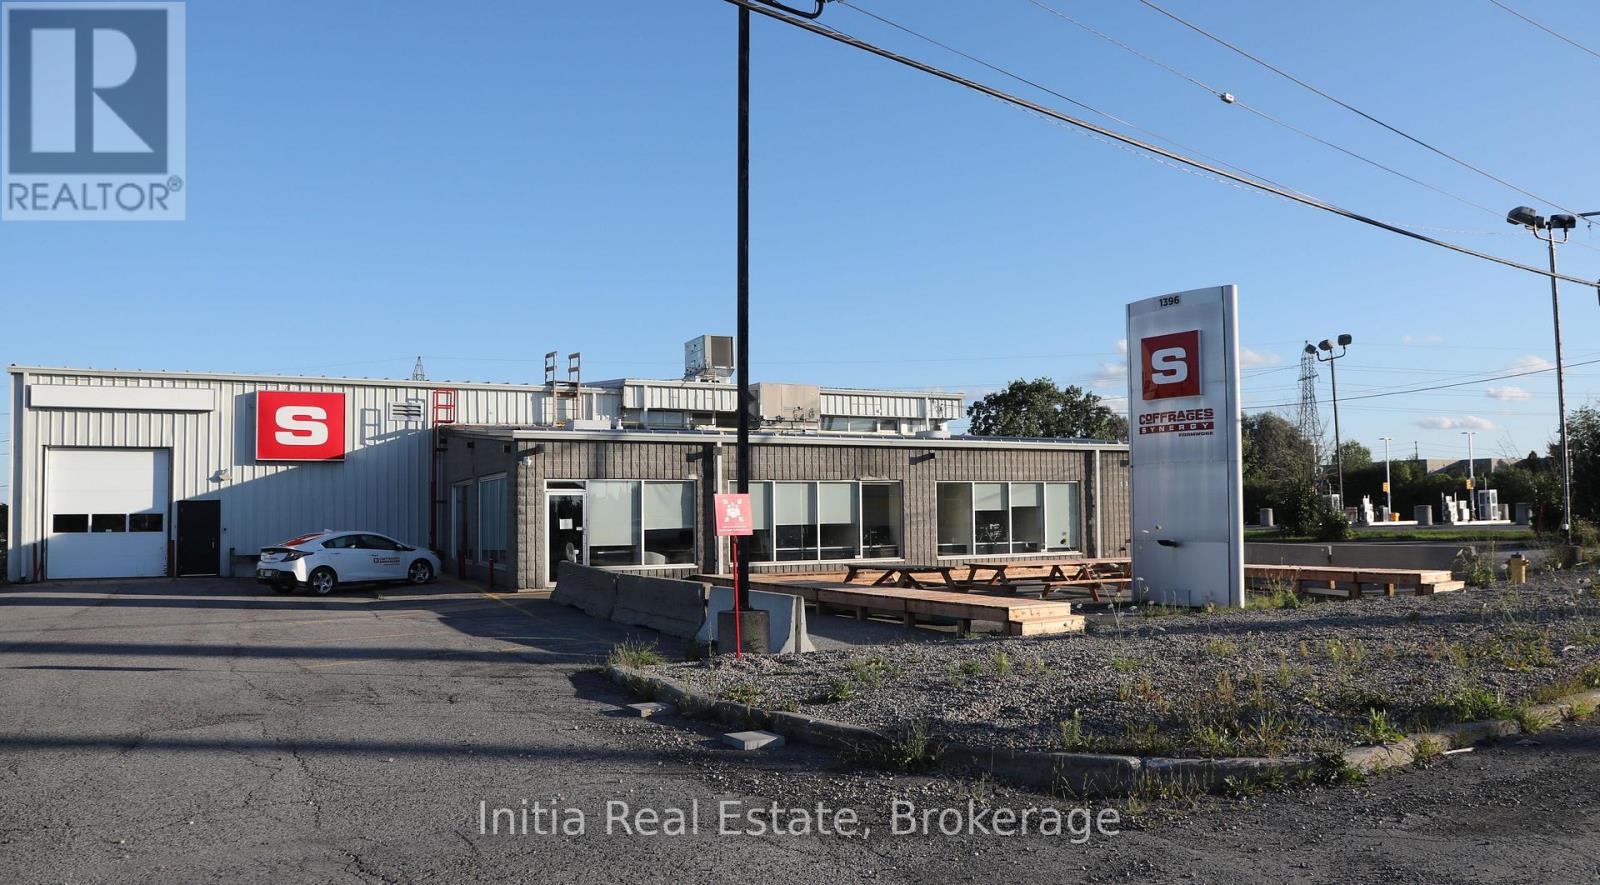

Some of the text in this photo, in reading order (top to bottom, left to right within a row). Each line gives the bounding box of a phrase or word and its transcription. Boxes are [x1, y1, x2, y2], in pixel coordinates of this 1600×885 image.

[1159, 296, 1180, 307] 1396
[1151, 347, 1188, 385] S
[1139, 408, 1213, 425] COFFRAGES
[275, 405, 328, 446] S
[1141, 422, 1209, 434] SYNERGY
